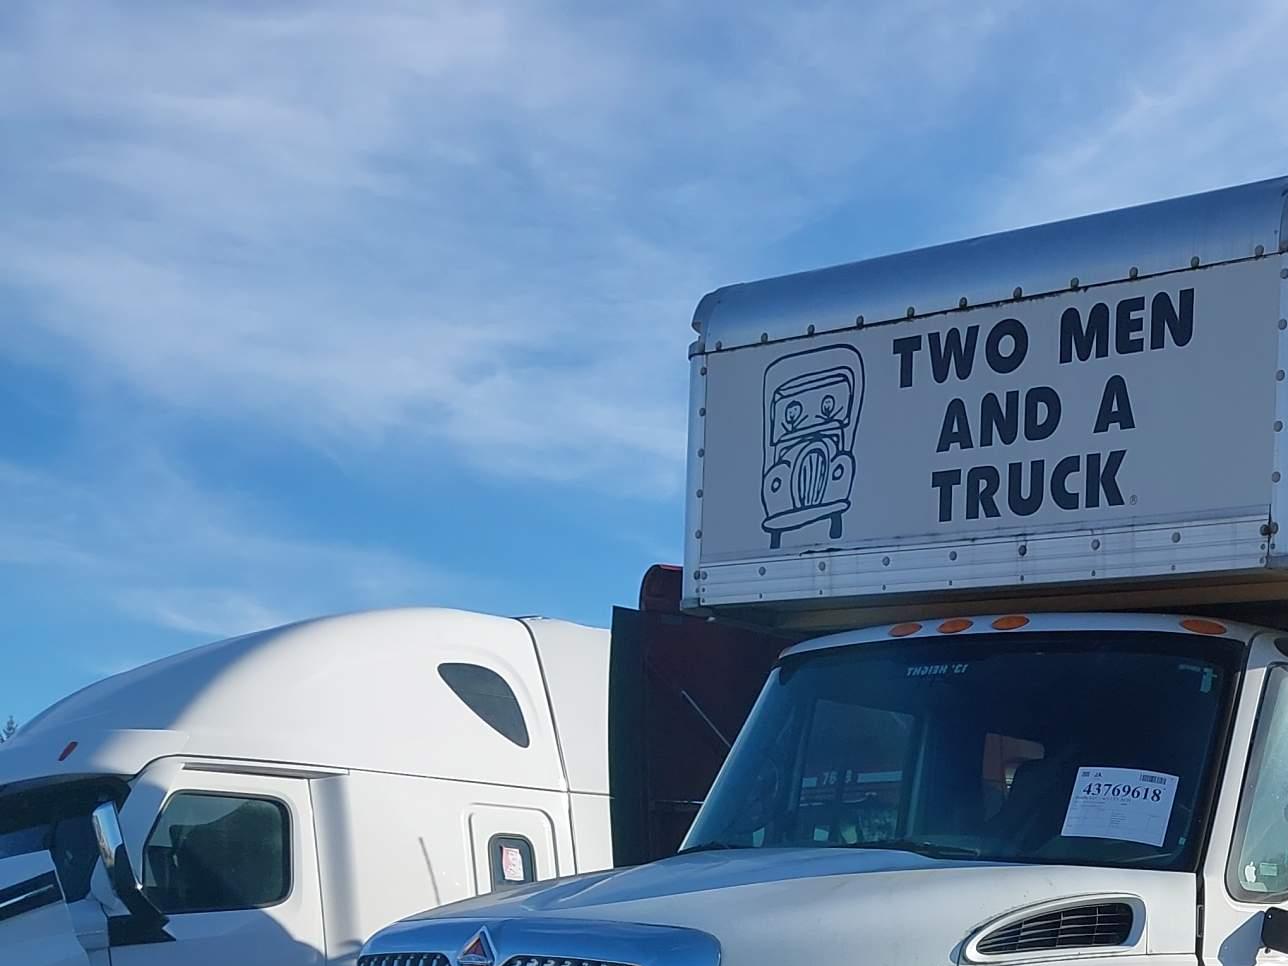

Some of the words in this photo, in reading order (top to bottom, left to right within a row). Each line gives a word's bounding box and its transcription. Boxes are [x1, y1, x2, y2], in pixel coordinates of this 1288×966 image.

[893, 319, 1029, 389] TWO
[1059, 287, 1195, 365] MEN
[935, 386, 1062, 453] AND
[1093, 375, 1136, 434] A
[931, 450, 1127, 523] TRUCK
[1083, 782, 1162, 802] 43769618
